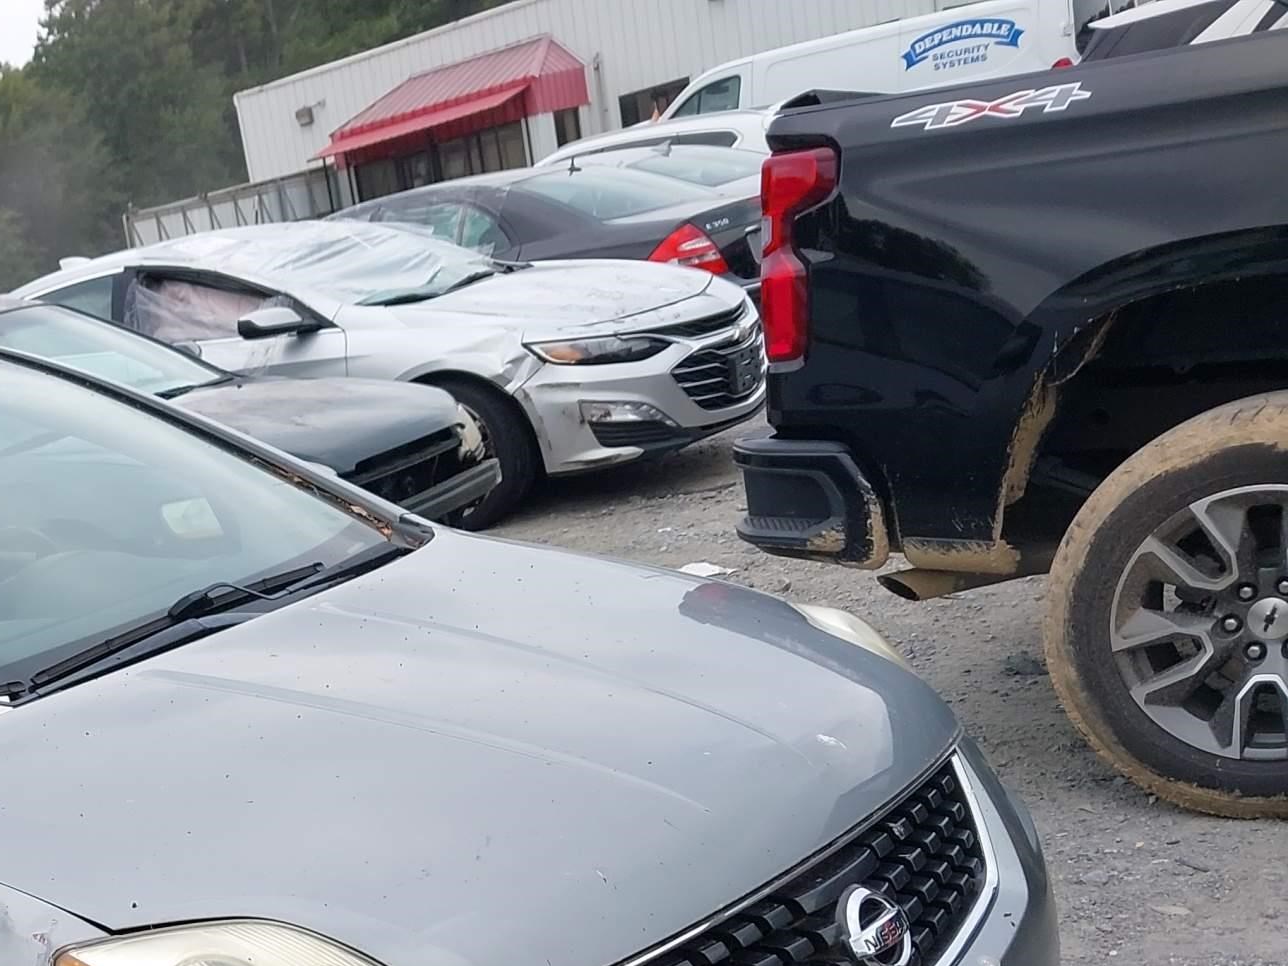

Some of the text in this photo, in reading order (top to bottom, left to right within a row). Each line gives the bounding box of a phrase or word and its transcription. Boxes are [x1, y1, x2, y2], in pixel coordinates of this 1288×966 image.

[913, 22, 1010, 54] DEPENDABLE
[932, 43, 991, 62] SECURITY
[933, 54, 988, 71] SYSTEMS
